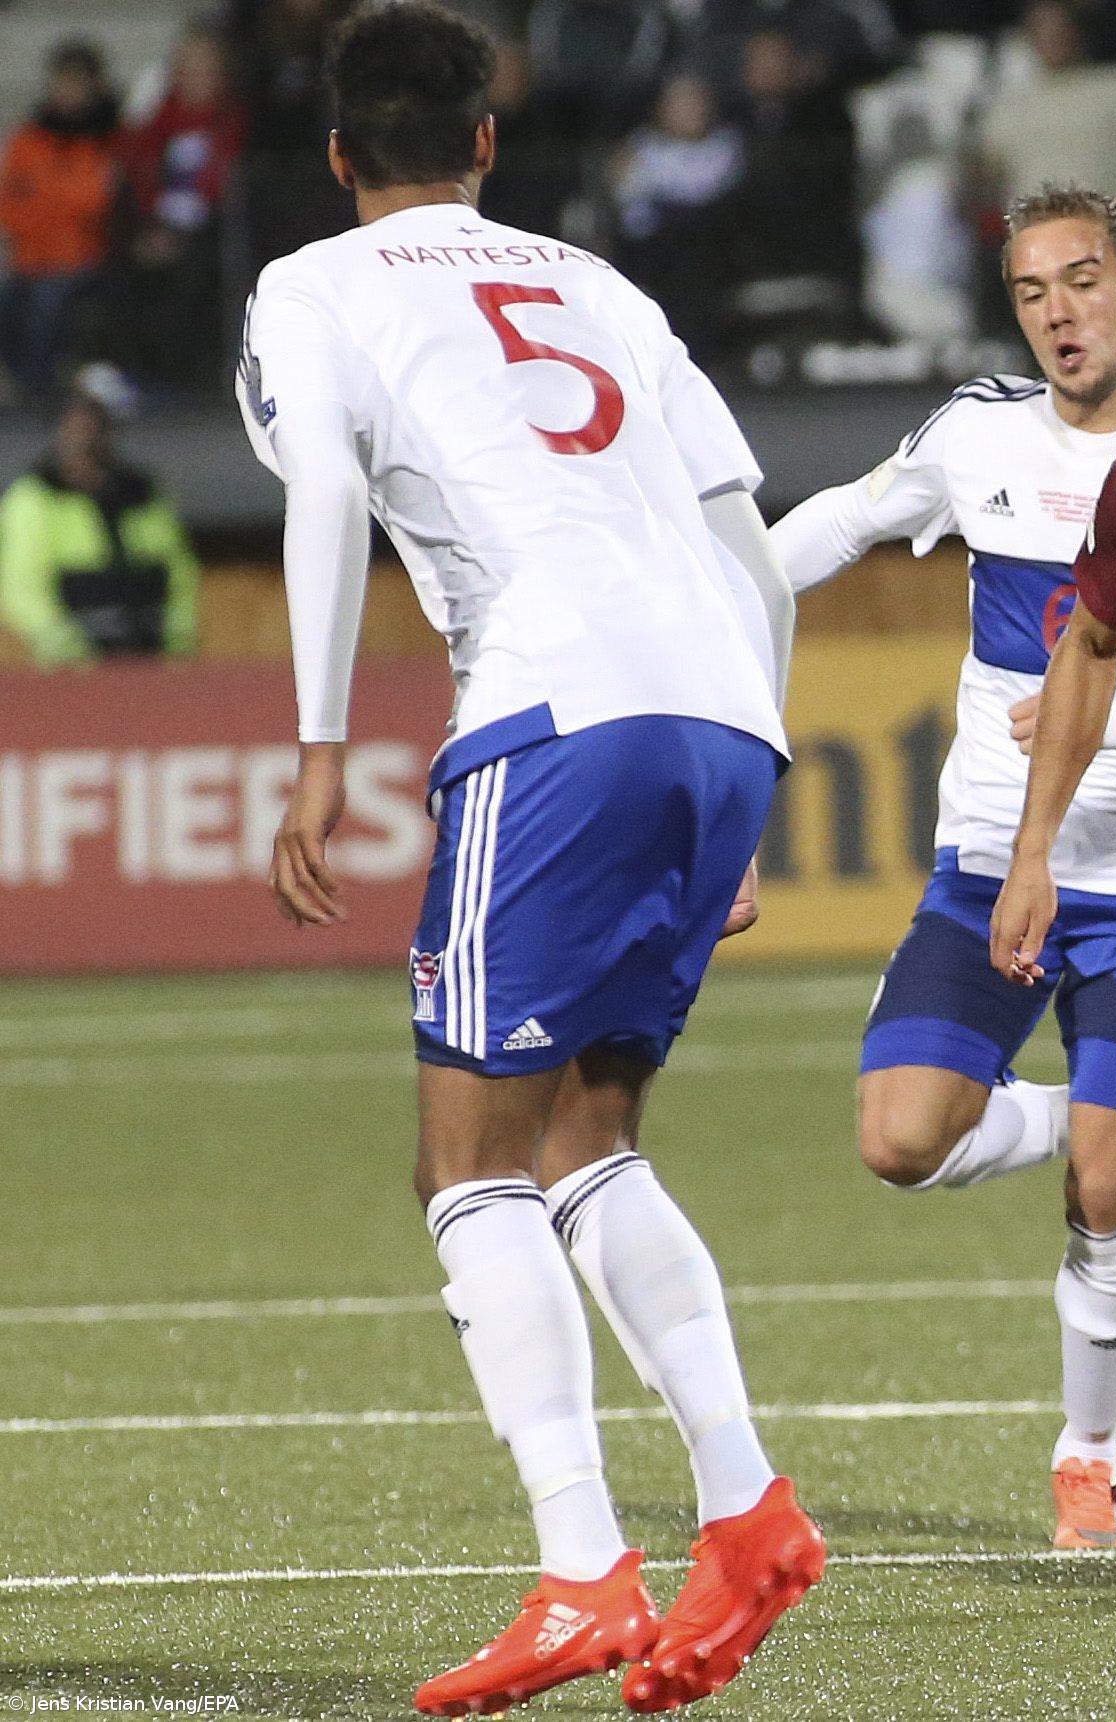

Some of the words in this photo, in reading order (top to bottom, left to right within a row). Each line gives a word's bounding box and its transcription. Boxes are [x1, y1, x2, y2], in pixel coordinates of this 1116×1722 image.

[470, 281, 625, 456] 5
[502, 1036, 554, 1051] adidas
[534, 1611, 597, 1660] adidas
